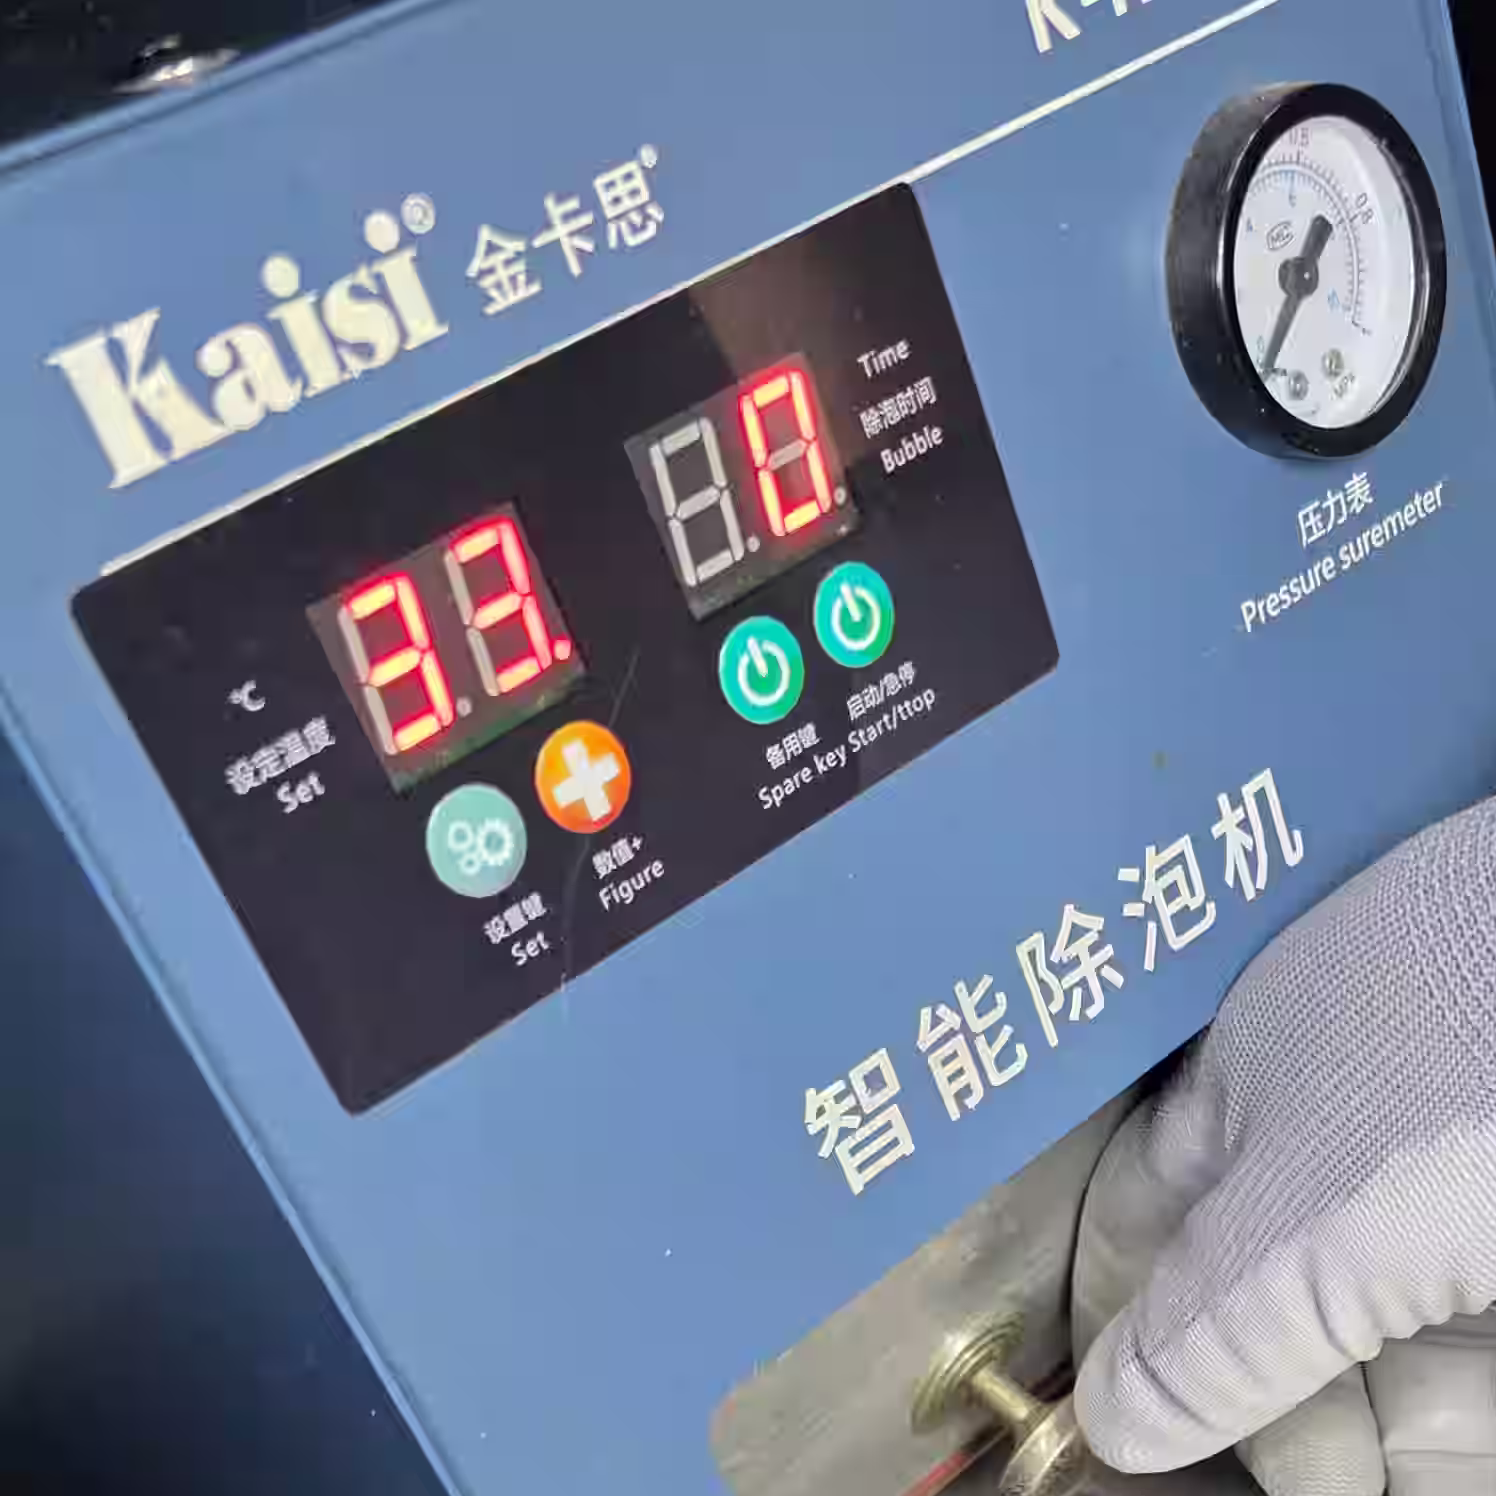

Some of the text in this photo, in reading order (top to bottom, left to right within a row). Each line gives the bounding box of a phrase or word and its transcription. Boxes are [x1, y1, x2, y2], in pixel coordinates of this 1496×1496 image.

[465, 158, 665, 315] 金卡思
[856, 339, 911, 379] Time
[860, 376, 937, 439] 除泡时间
[880, 424, 943, 473] Bubble
[1297, 471, 1374, 549] 压力表
[1240, 482, 1443, 633] Pressure suremeter
[758, 688, 936, 810] Spare key Start/ttop
[276, 771, 325, 814] Set
[599, 859, 665, 911] Figure
[511, 930, 550, 966] Set
[804, 767, 1305, 1196] 智能除泡机
